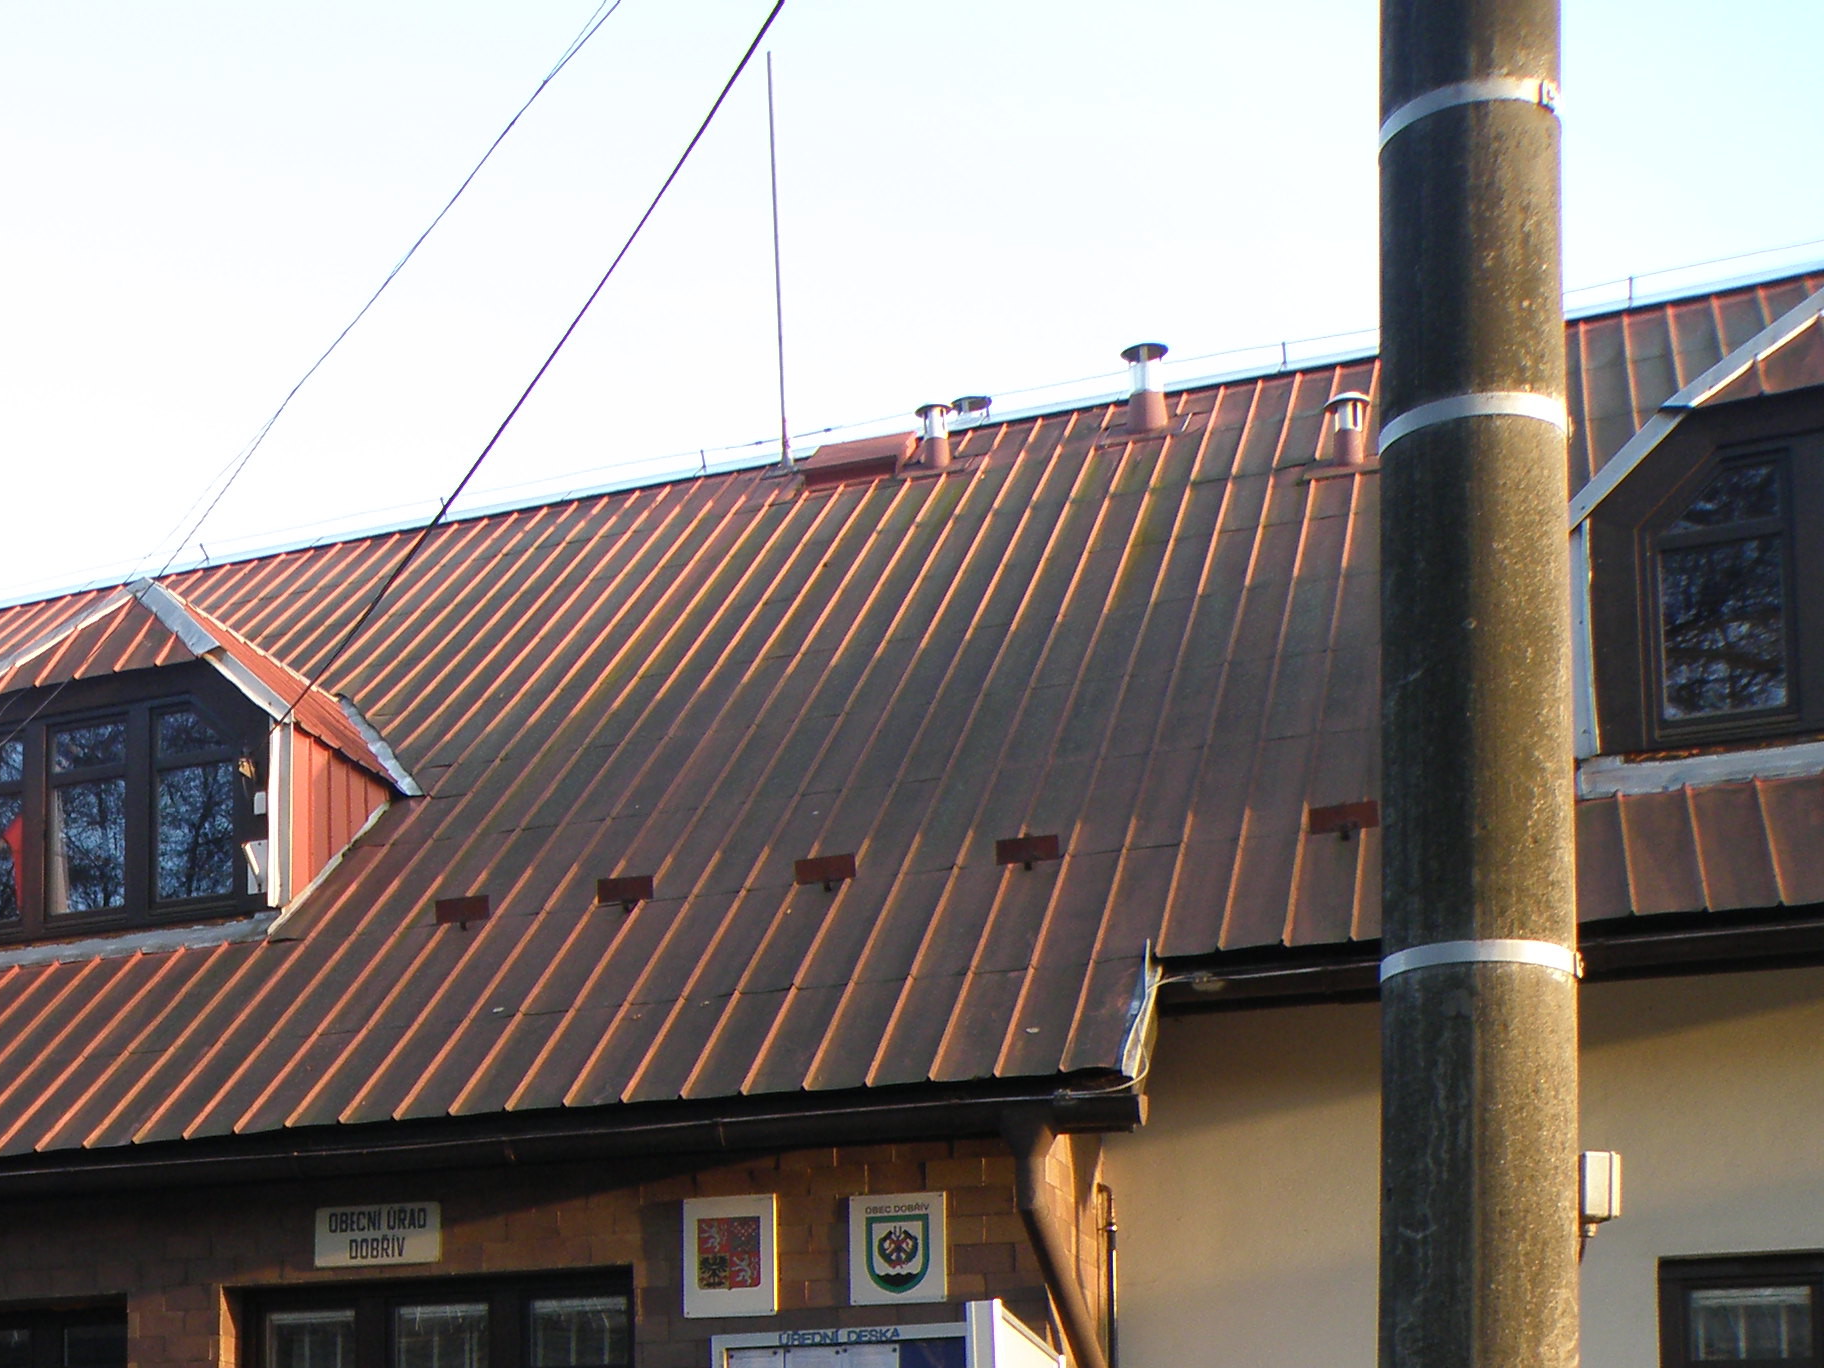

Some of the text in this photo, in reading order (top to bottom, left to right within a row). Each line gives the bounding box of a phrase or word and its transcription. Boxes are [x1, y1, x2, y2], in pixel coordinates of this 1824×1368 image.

[328, 1205, 427, 1233] OBECNÍ ÚŘAD
[865, 1205, 891, 1215] OBEC
[349, 1233, 406, 1260] DOBŘÍV
[778, 1327, 900, 1346] ÚŘEDNÍ DESKA
